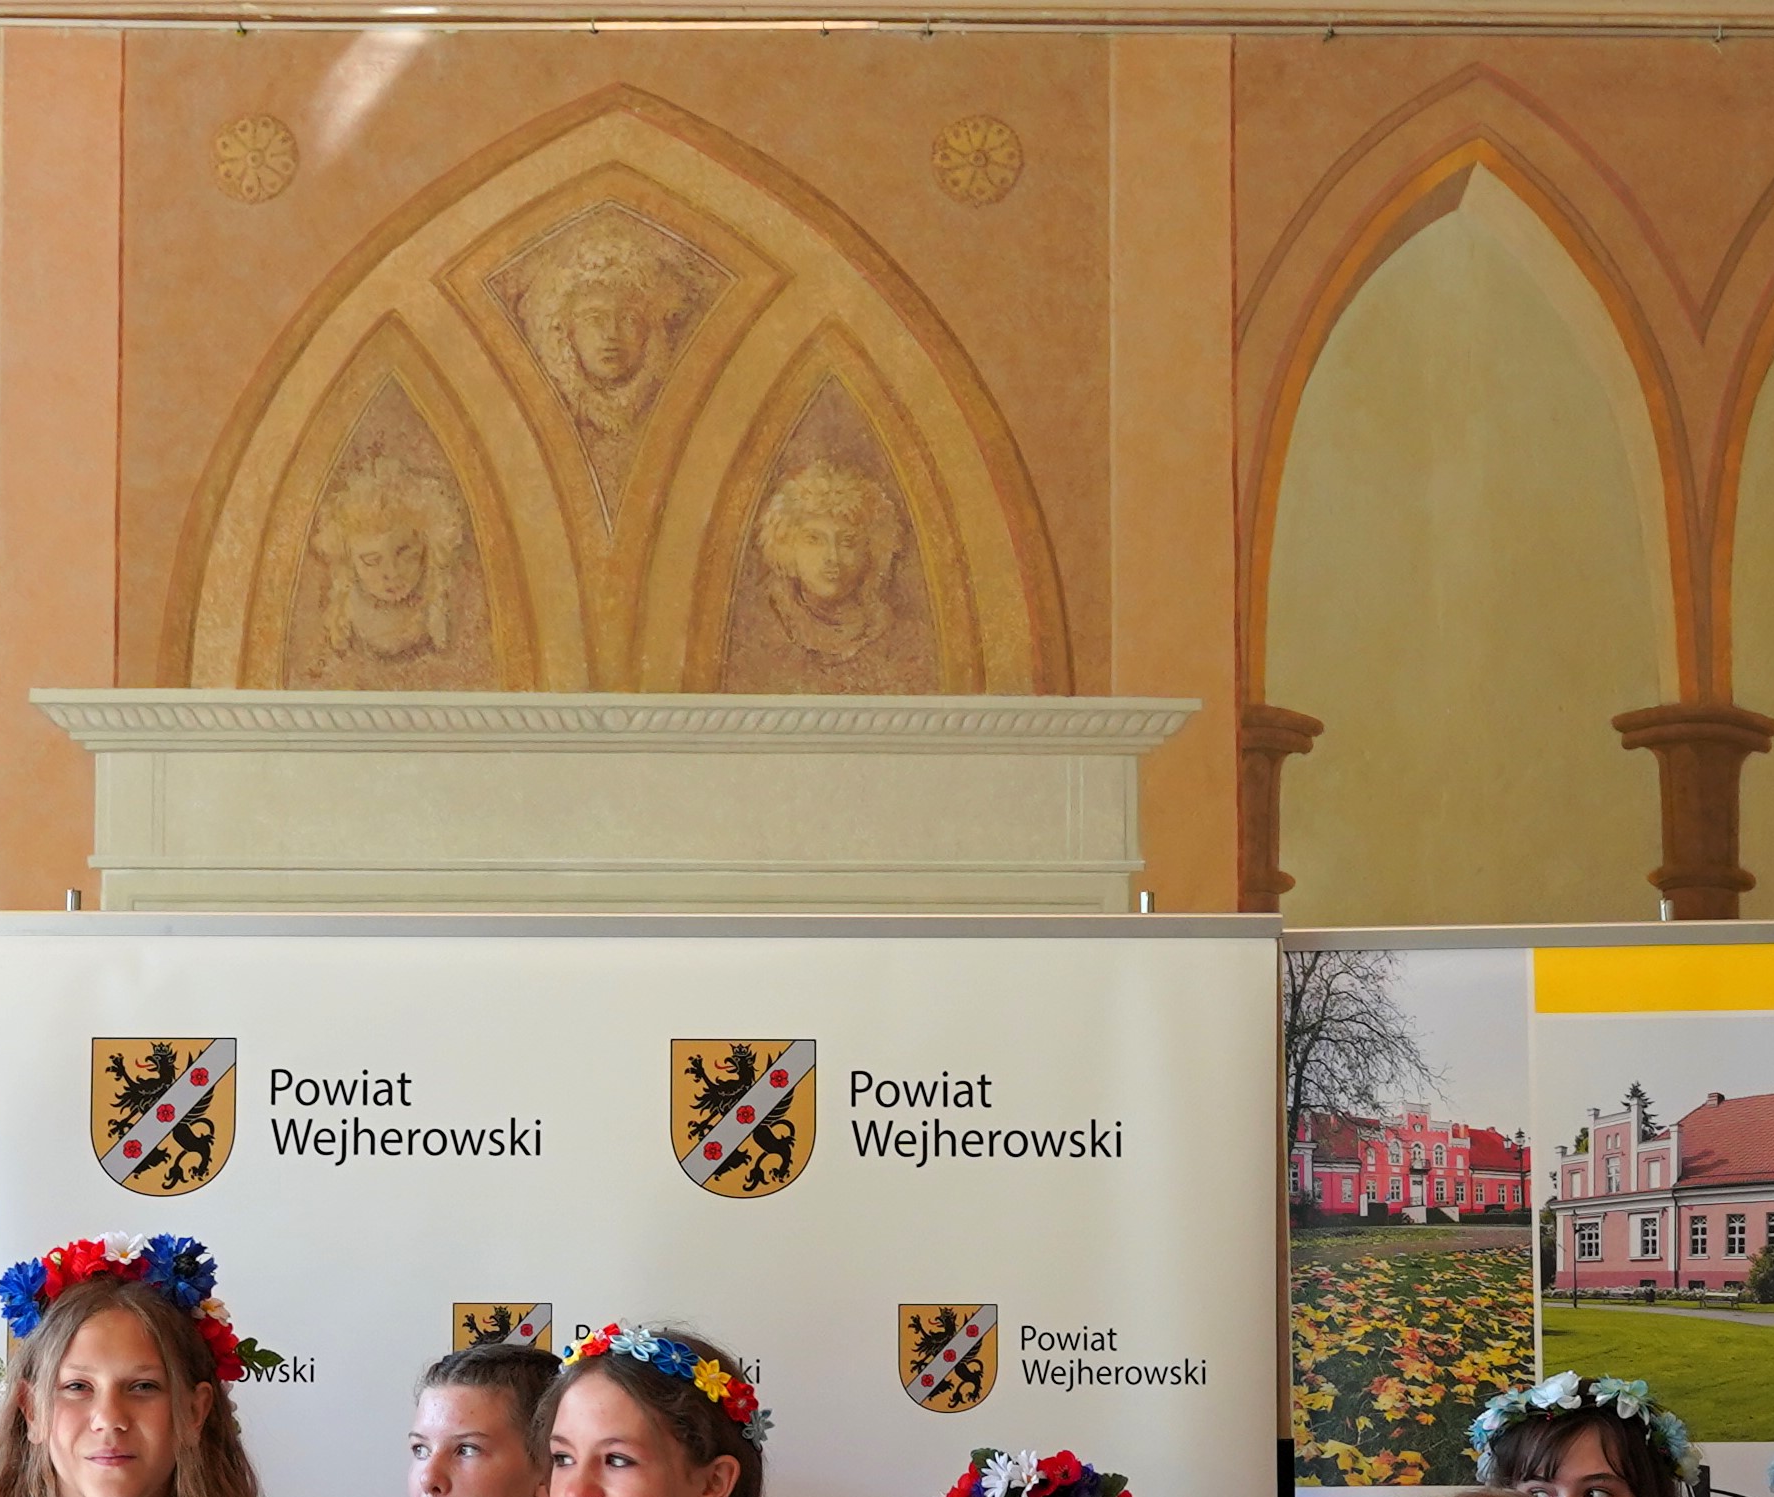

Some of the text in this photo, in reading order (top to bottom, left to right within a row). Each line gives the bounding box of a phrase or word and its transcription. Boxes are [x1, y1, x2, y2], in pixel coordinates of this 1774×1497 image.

[270, 1068, 412, 1107] Powiat
[851, 1070, 992, 1108] Powiat
[271, 1116, 542, 1167] Wejherowski
[851, 1118, 1122, 1168] Wejherowski
[1021, 1325, 1118, 1352] Powiat
[1021, 1358, 1206, 1393] Wejherowski
